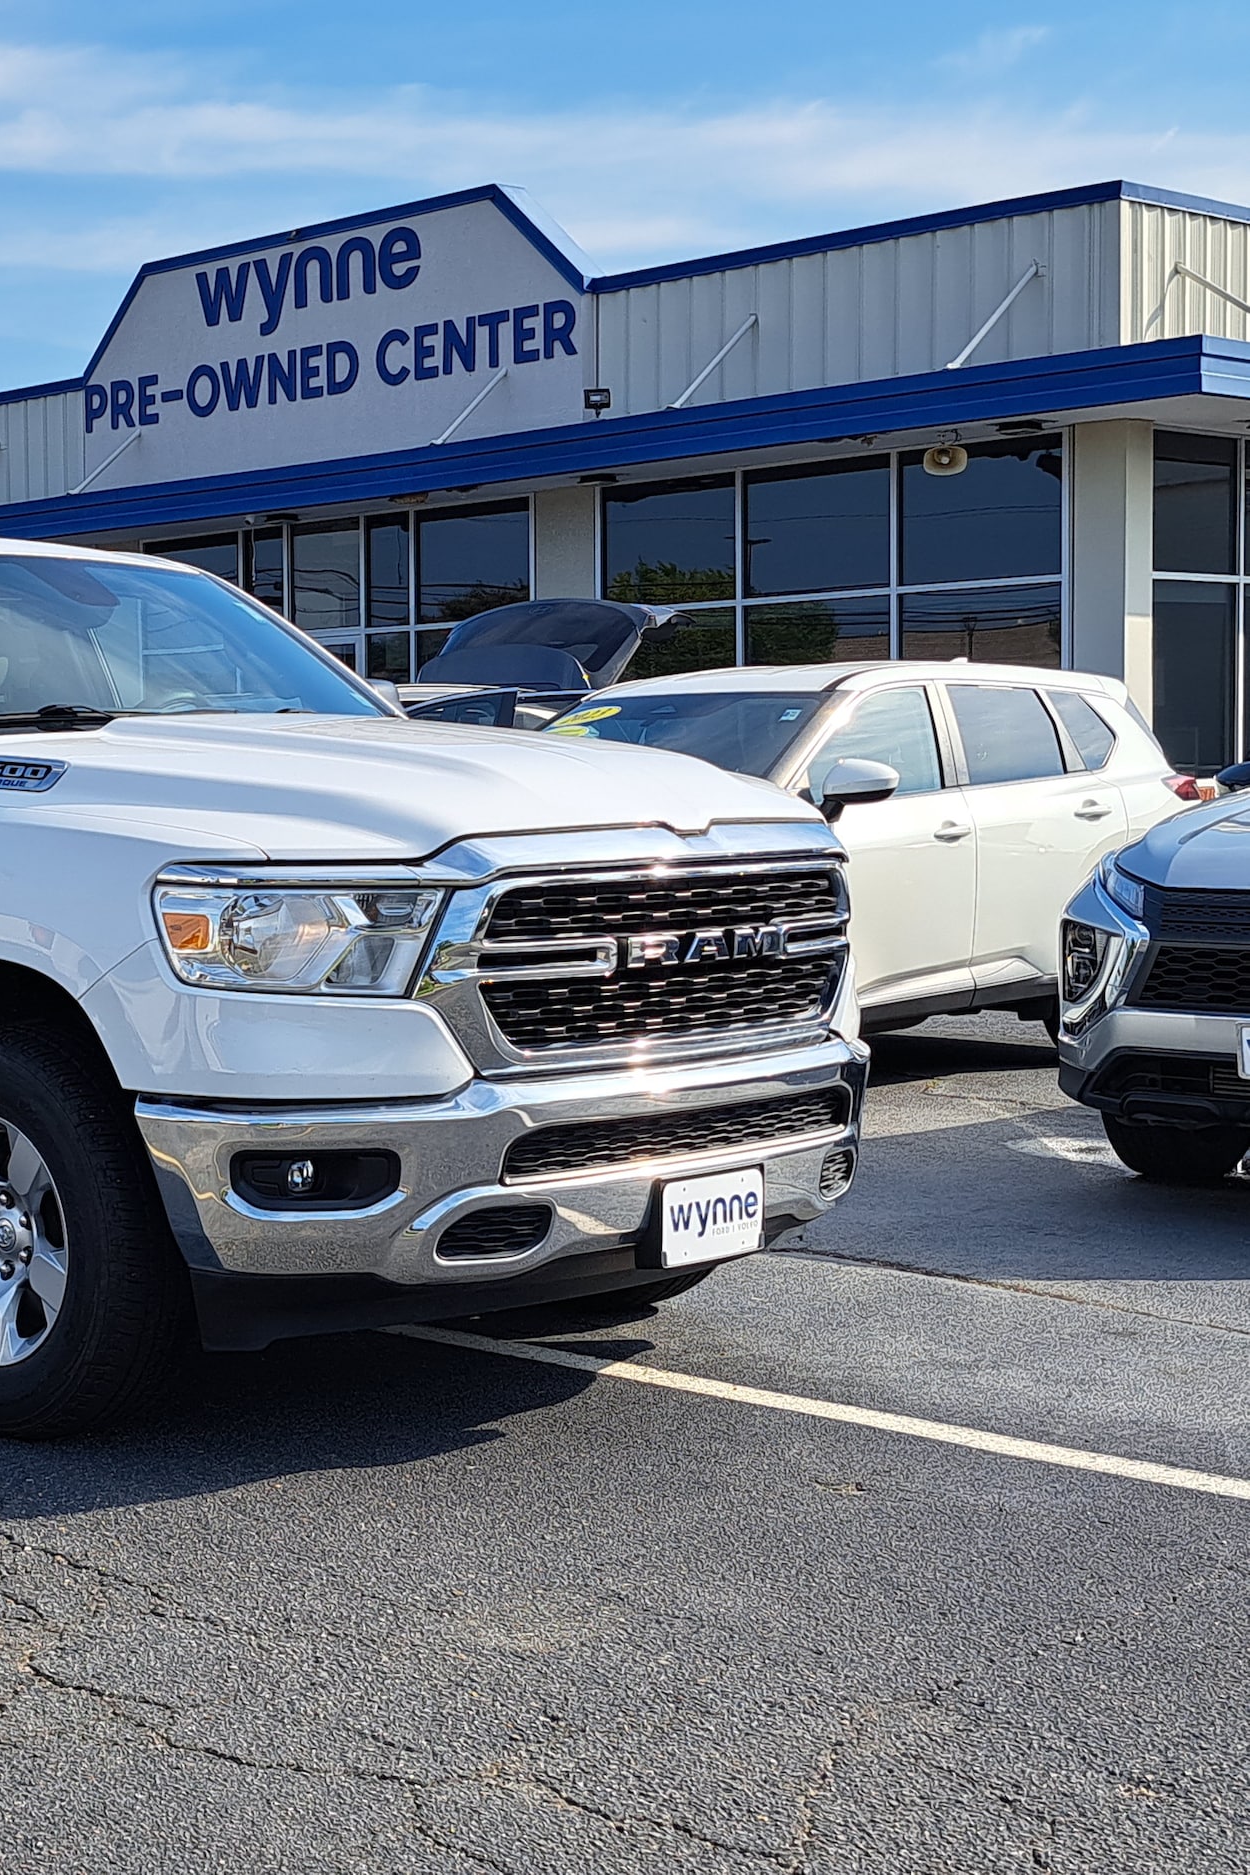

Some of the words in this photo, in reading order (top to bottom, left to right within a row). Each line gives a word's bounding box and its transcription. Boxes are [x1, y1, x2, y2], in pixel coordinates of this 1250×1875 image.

[196, 226, 422, 336] wynne
[85, 341, 360, 434] PRE-OWNED
[376, 299, 578, 386] CENTER
[627, 926, 781, 968] RAM
[669, 1191, 758, 1238] wynne
[712, 1226, 730, 1236] FORD
